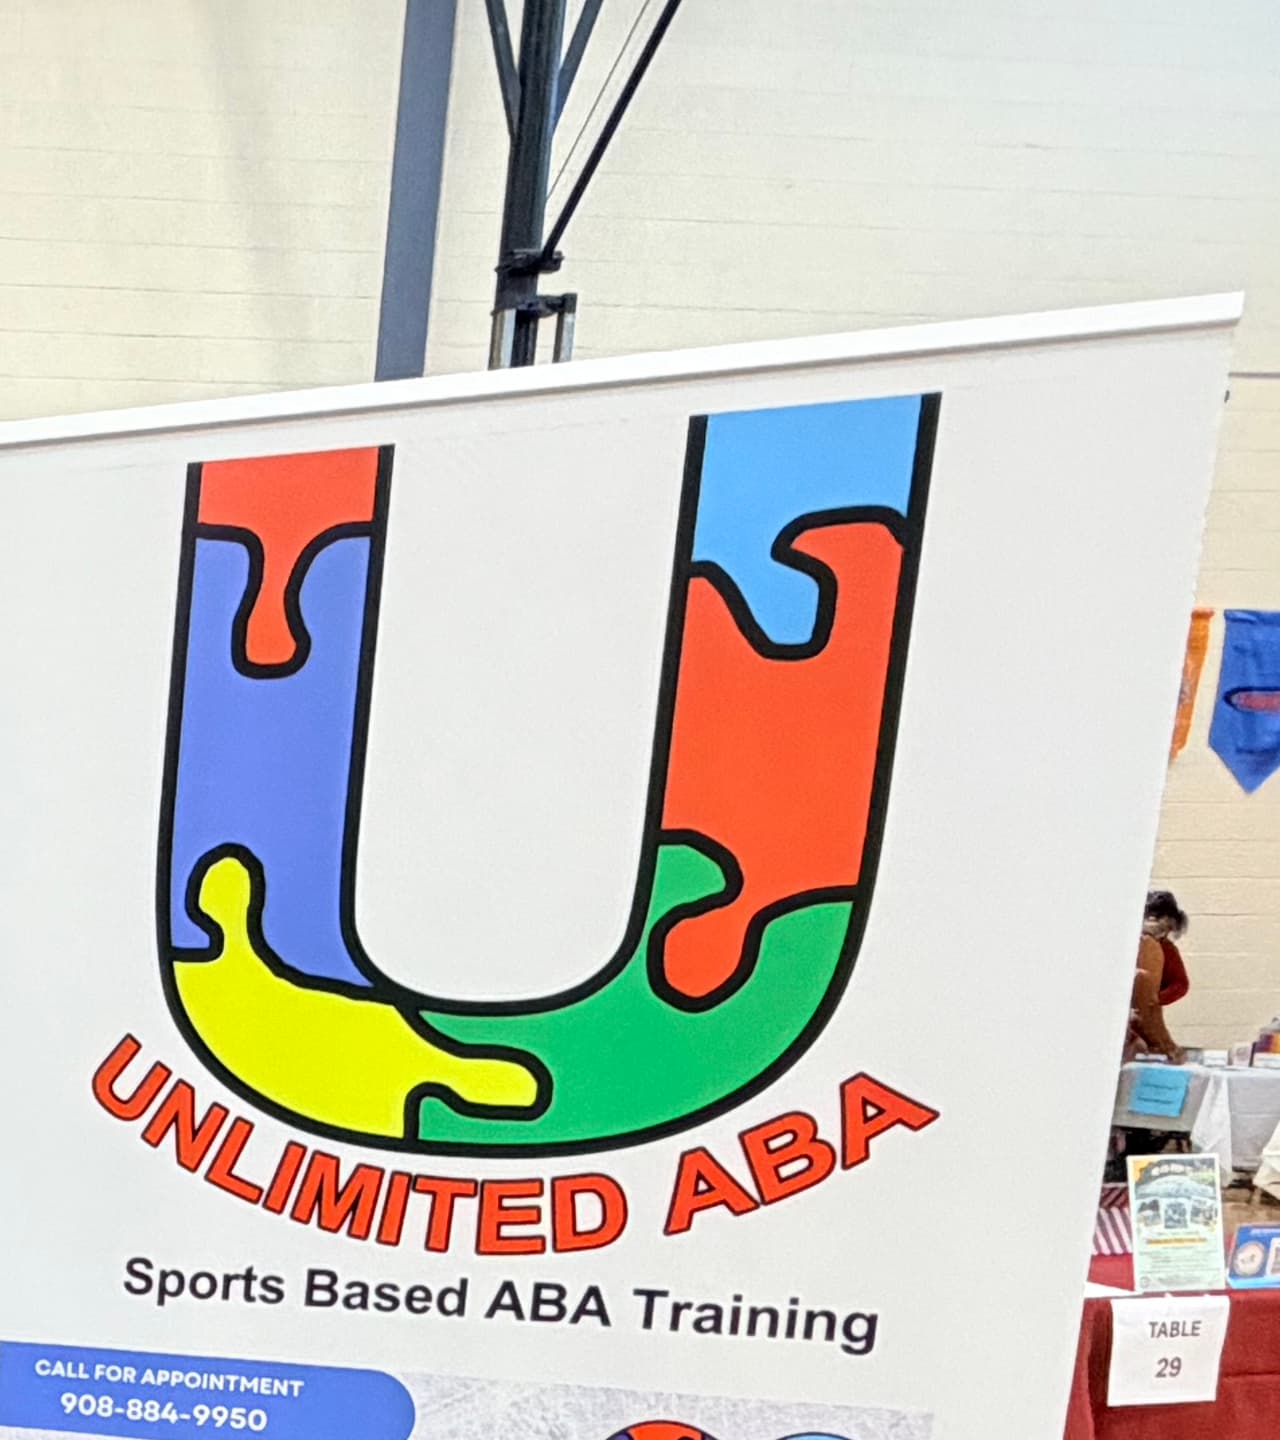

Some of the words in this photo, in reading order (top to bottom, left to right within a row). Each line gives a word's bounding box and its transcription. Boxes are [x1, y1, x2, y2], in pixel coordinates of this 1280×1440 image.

[91, 1034, 628, 1256] UNLIMITED
[664, 1072, 940, 1236] ABA
[122, 1255, 286, 1312] Sports
[305, 1265, 468, 1320] Based
[484, 1278, 611, 1327] ABA
[633, 1288, 879, 1354] Training
[1149, 1320, 1201, 1339] TABLE
[35, 1359, 89, 1380] CALL
[94, 1364, 137, 1385] FOR
[141, 1368, 304, 1398] APPOINTMENT
[1155, 1357, 1182, 1379] 29
[60, 1392, 268, 1432] 908-884-9950
